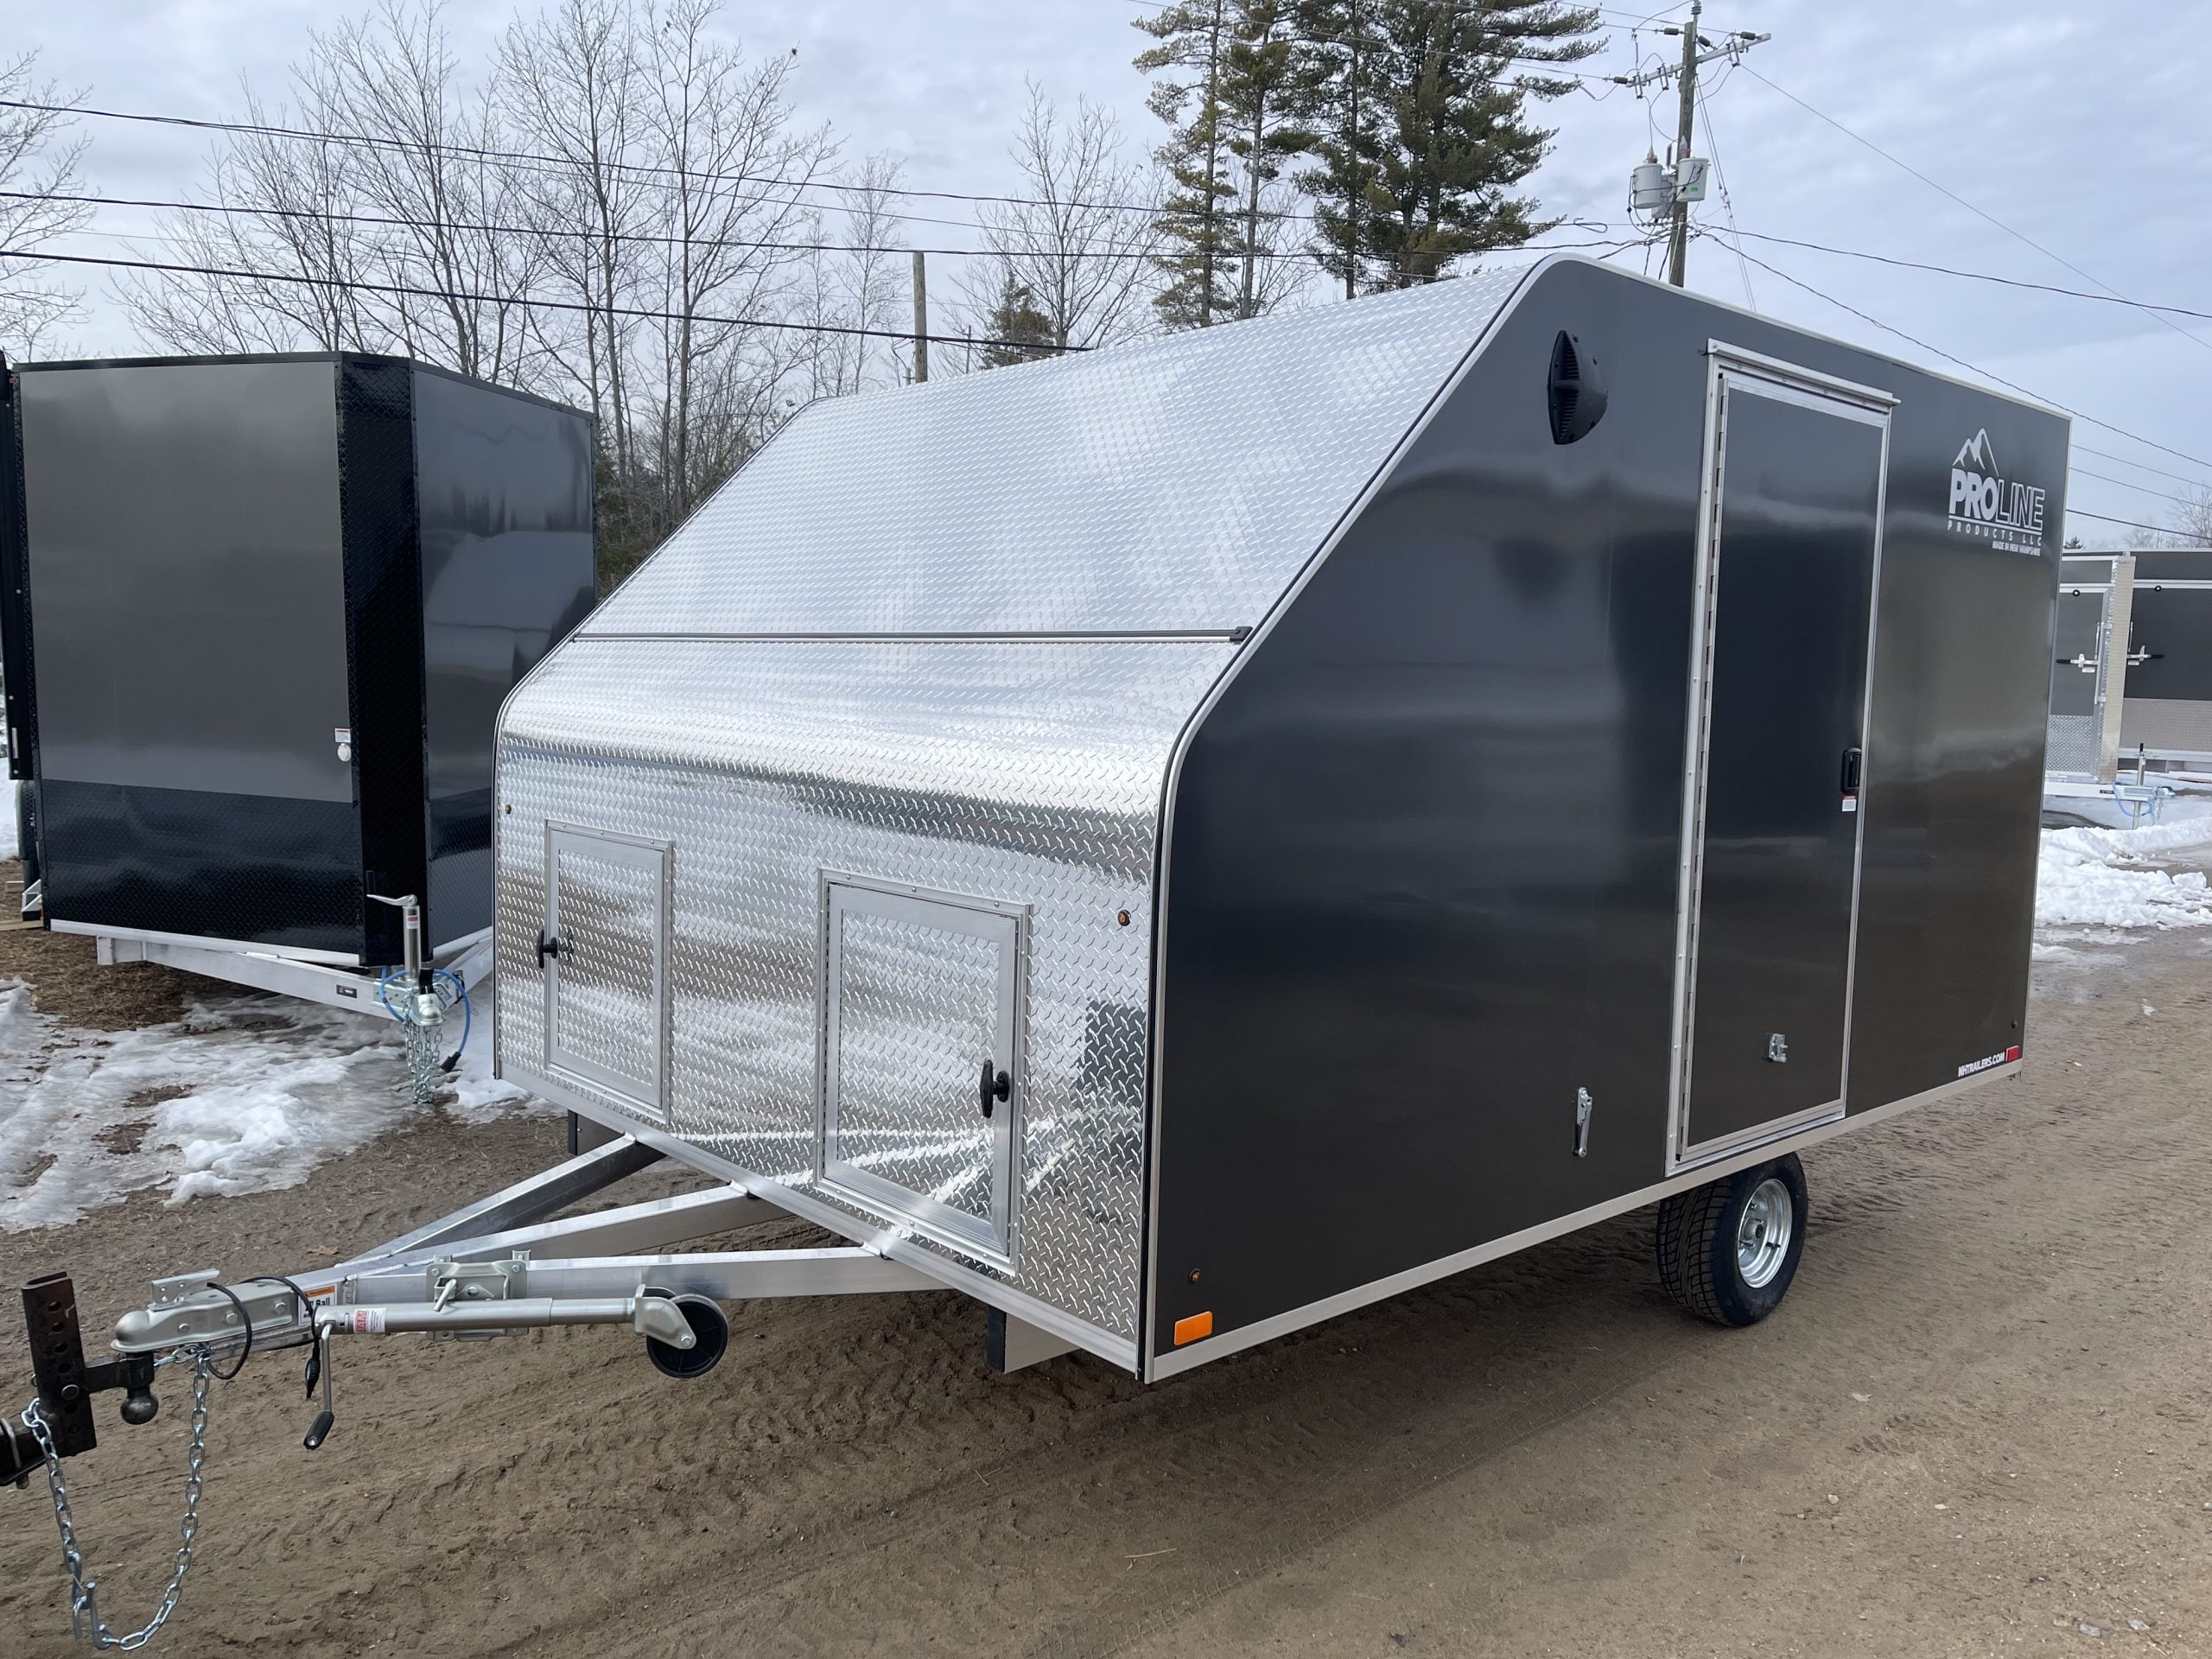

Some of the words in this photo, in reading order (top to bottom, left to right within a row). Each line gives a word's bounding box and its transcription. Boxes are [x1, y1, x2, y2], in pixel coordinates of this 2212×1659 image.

[1948, 520, 2013, 541] PRODUCTS
[2023, 533, 2042, 546] LLC
[1958, 1052, 2005, 1077] NHTRAILERS.COM
